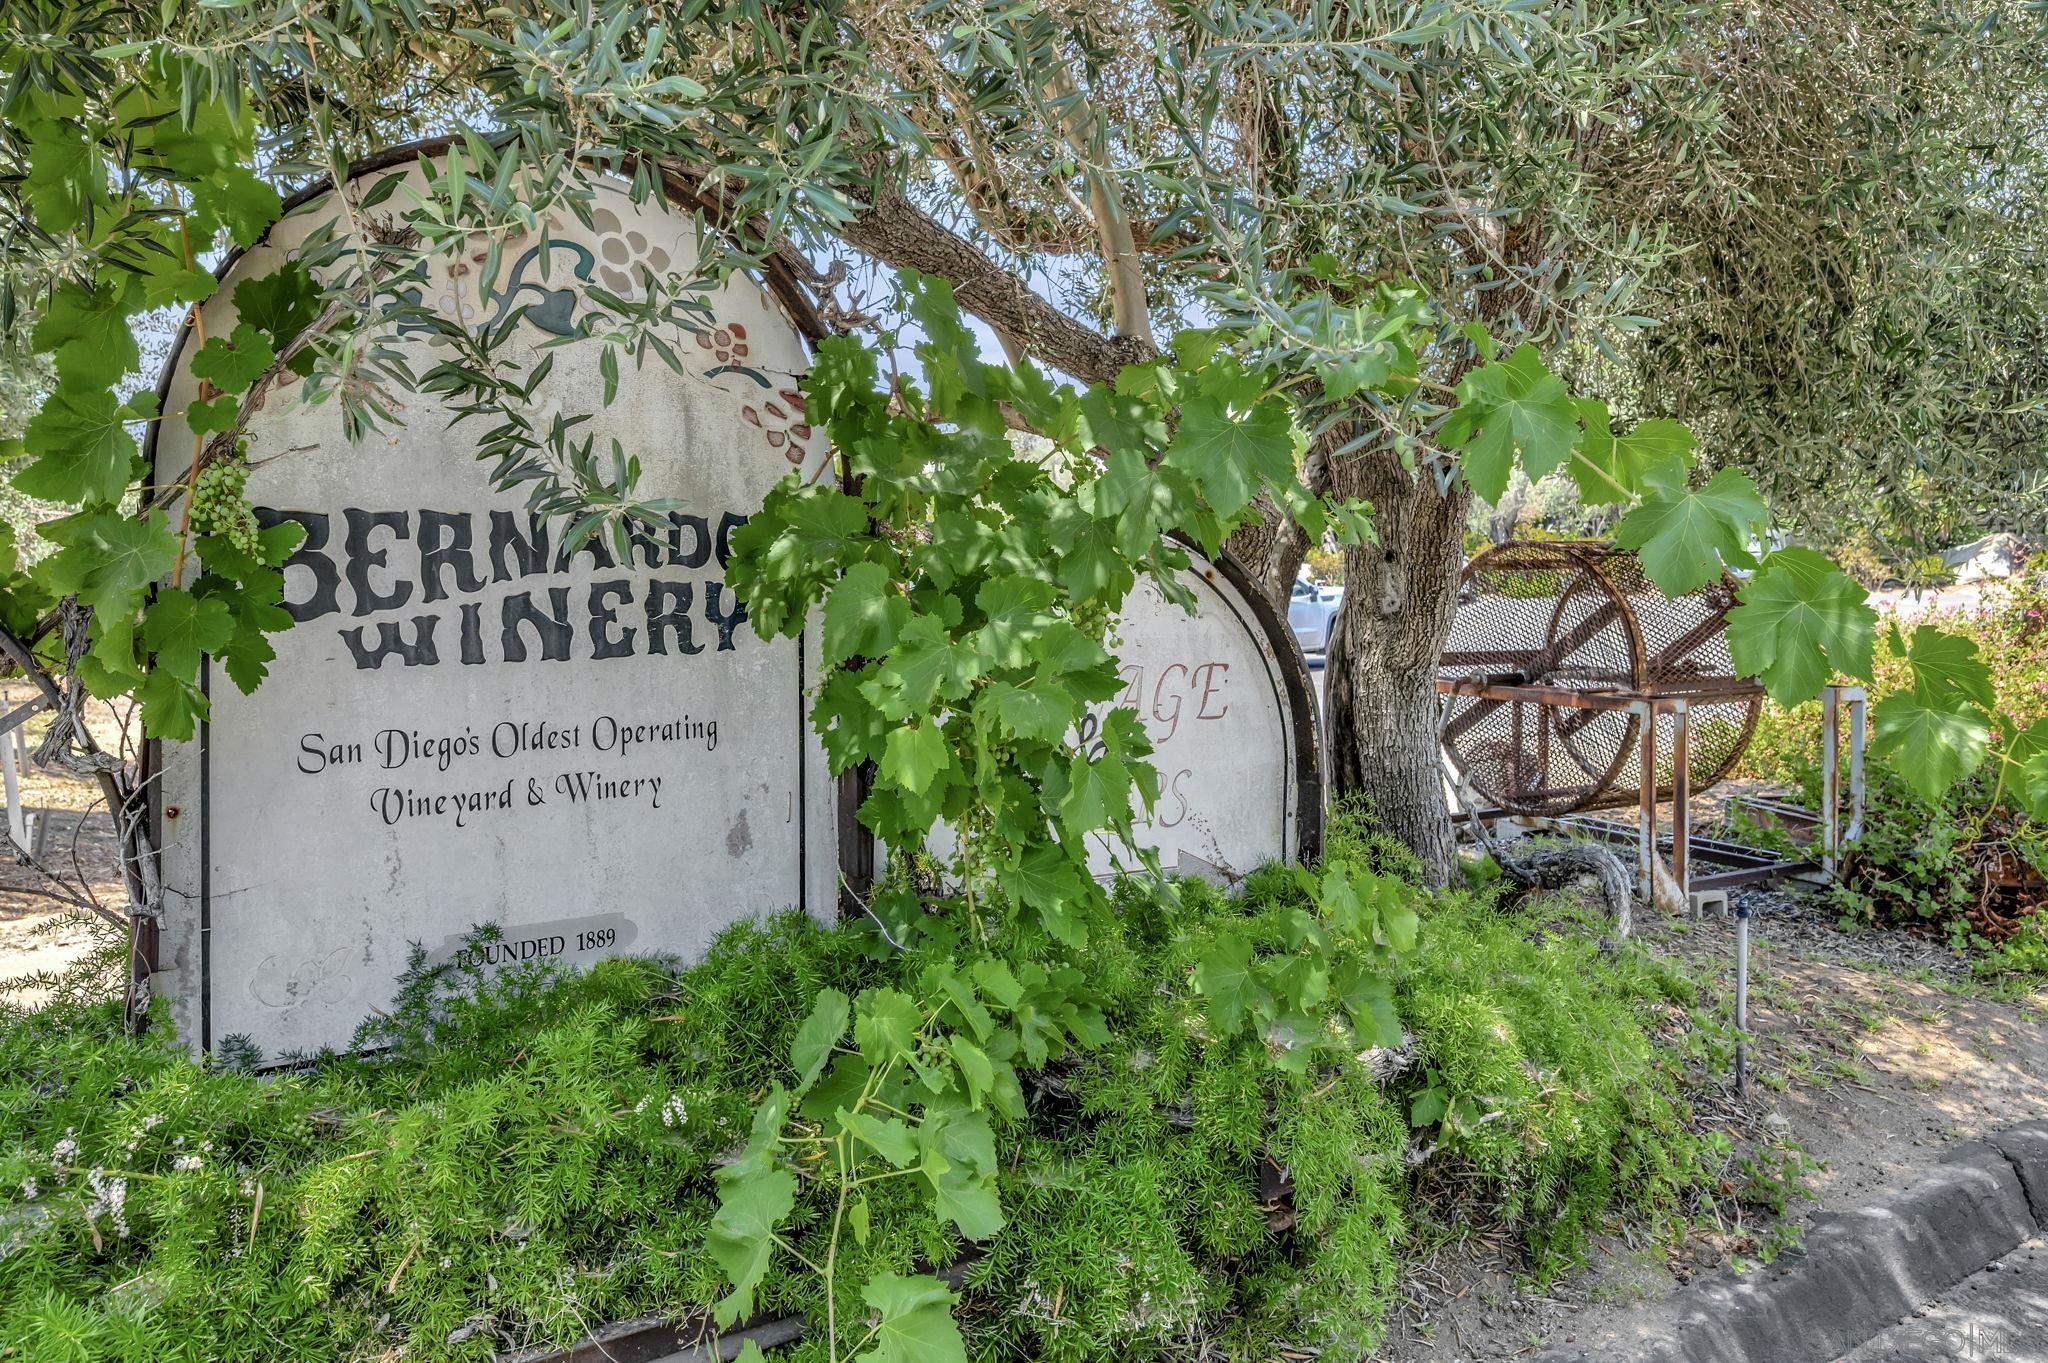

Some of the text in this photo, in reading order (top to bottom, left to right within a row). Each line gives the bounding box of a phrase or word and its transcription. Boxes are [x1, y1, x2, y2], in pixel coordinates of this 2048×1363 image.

[338, 579, 748, 670] WINERY
[297, 714, 718, 774] San Diego's Oldest Operating
[370, 771, 662, 828] Vineyard & Winery
[577, 928, 616, 951] 1889
